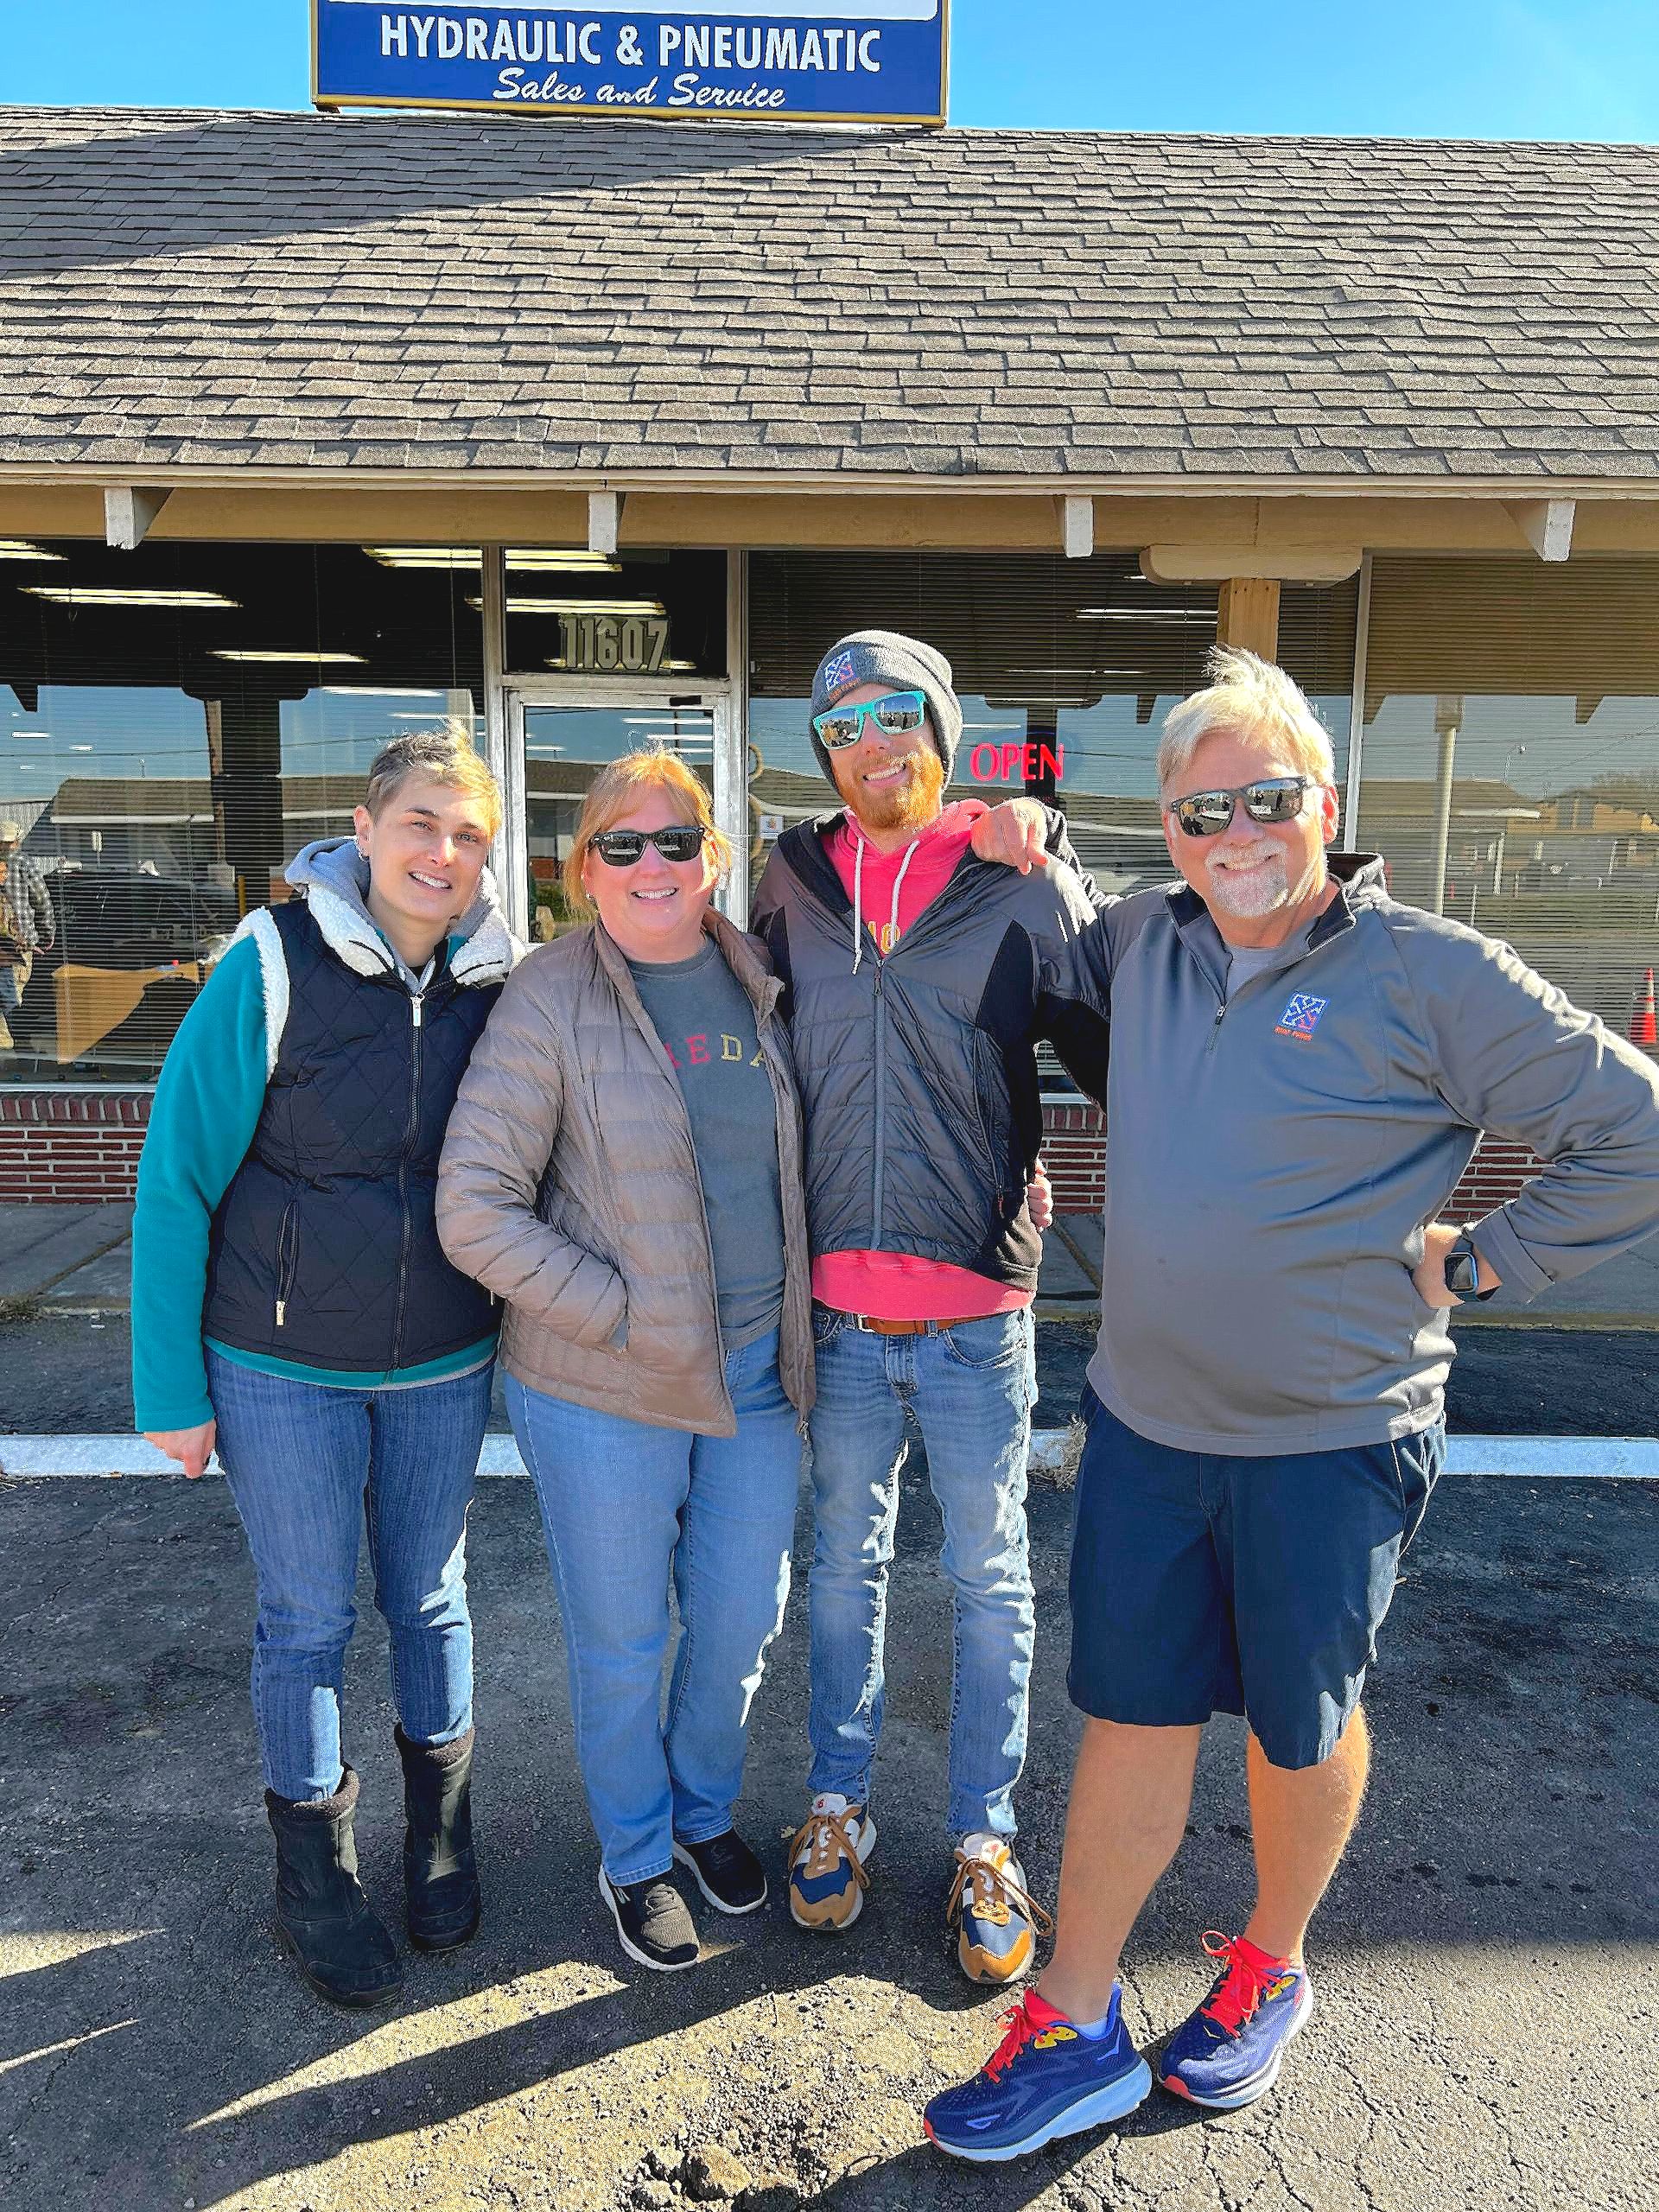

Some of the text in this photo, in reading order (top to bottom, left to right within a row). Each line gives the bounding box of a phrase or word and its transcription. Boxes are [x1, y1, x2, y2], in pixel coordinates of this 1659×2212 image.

[380, 14, 881, 73] HYDRAULIC & PNEUMATIC
[492, 67, 786, 108] Sales and Service
[563, 616, 669, 671] 11607
[969, 741, 1065, 782] OPEN
